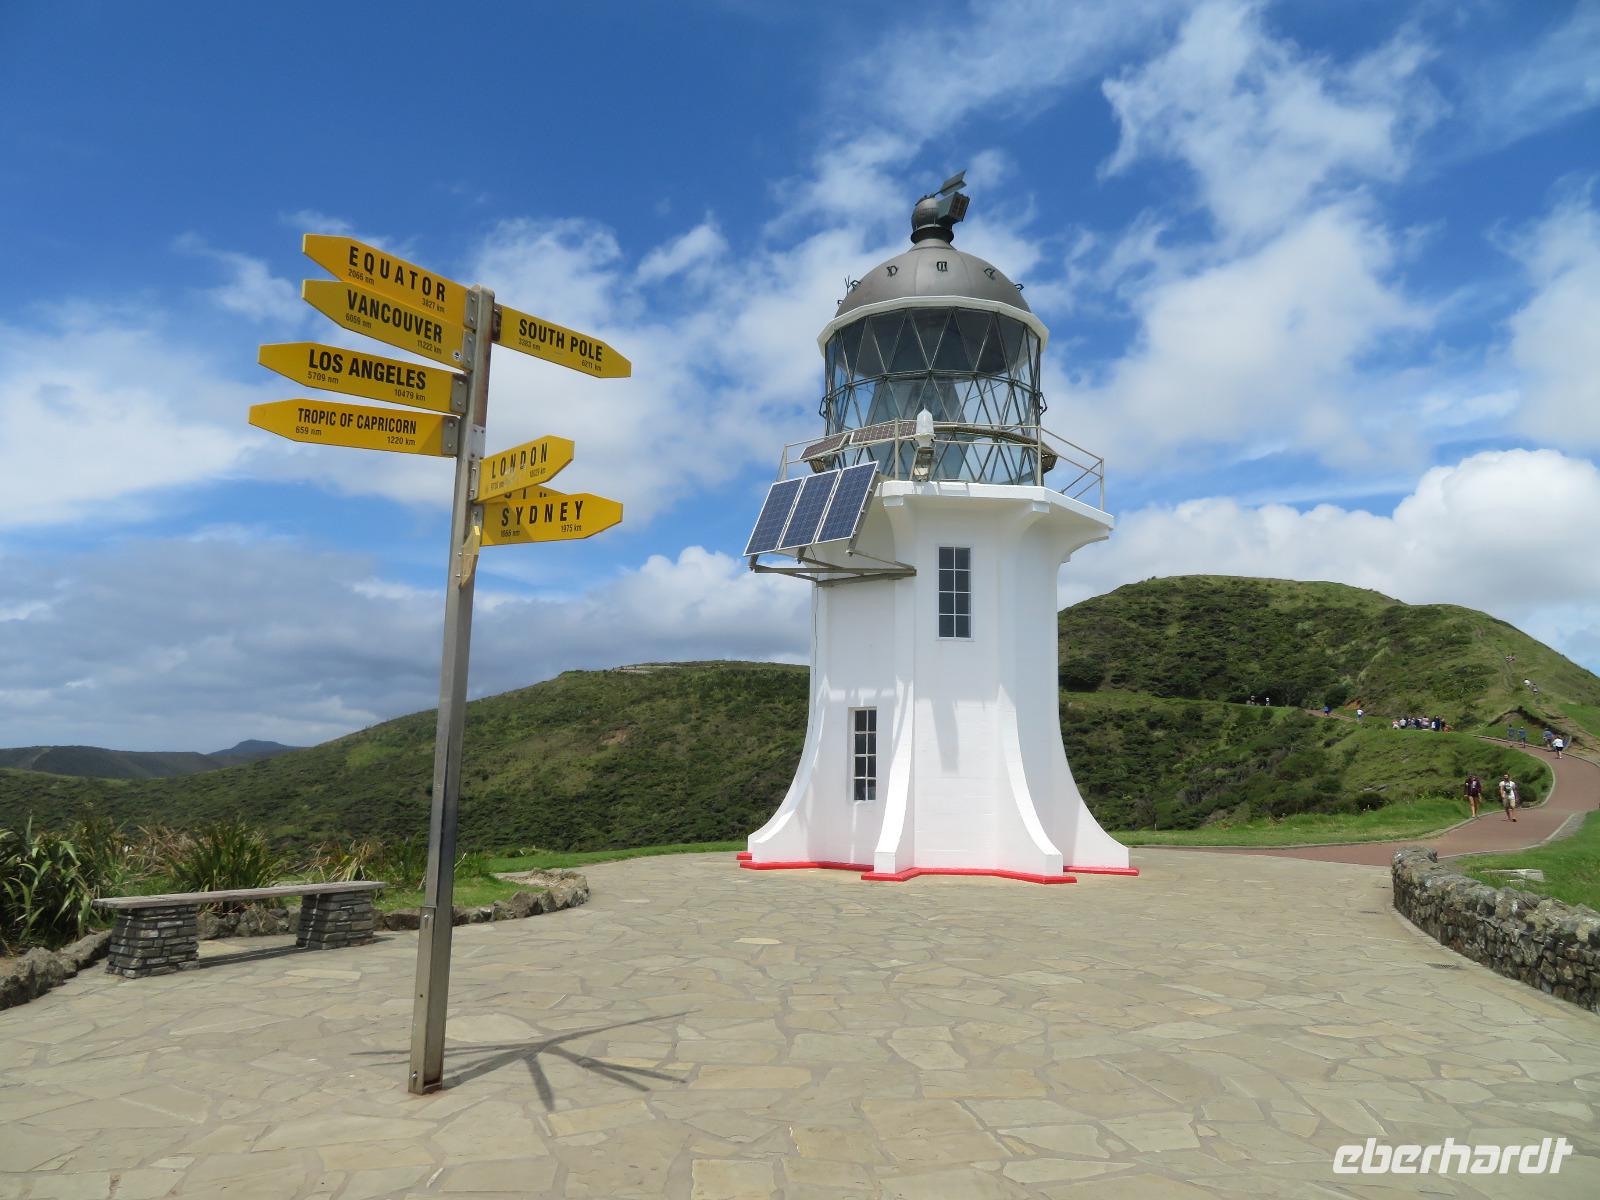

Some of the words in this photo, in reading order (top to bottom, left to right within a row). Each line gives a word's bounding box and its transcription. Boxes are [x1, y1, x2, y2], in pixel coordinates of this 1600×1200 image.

[349, 245, 446, 302] EQUATOR
[365, 276, 375, 286] nm
[436, 303, 445, 313] km
[345, 312, 361, 325] 6059
[362, 319, 372, 329] nm
[347, 289, 443, 344] VANCOUVER
[417, 339, 433, 352] 11222
[433, 344, 442, 354] km
[519, 318, 565, 349] SOUTH
[570, 337, 603, 362] POLE
[307, 371, 326, 383] 5709
[327, 376, 339, 384] nm
[309, 349, 343, 374] LOS
[348, 358, 427, 390] ANGELES
[394, 388, 414, 400] 10479
[415, 392, 426, 402] km
[298, 408, 336, 426] TROPIC
[340, 412, 354, 428] OF
[357, 414, 417, 435] CAPRICORN
[295, 426, 309, 435] 659
[310, 428, 322, 436] nm
[387, 436, 404, 445] 1220
[405, 437, 416, 446] km
[491, 442, 548, 479] LONDON
[501, 500, 584, 527] SYDNEY
[561, 524, 573, 533] 1975
[573, 523, 582, 532] km
